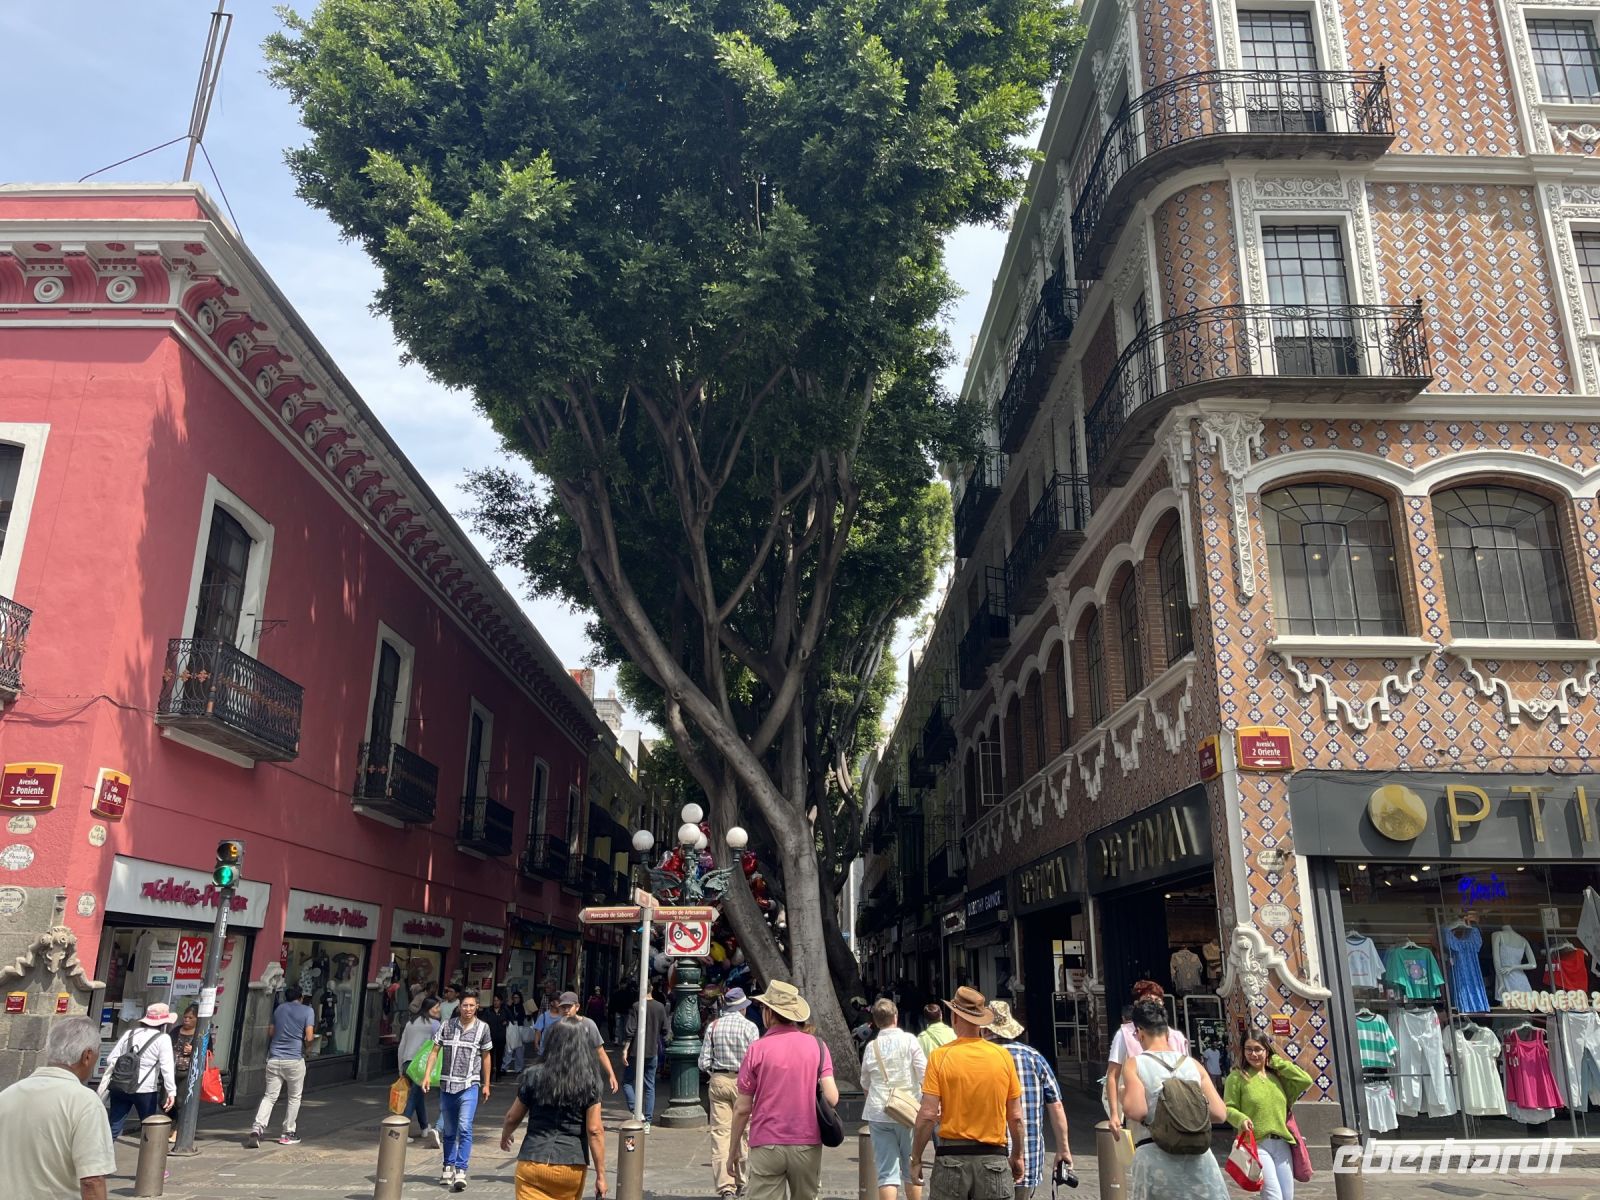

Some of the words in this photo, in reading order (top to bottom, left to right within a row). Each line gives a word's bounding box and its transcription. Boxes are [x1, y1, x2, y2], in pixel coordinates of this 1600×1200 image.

[1257, 748, 1281, 756] Oriente
[10, 787, 15, 795] 2
[16, 786, 45, 795] Poniente
[179, 940, 204, 963] 3x2
[177, 966, 188, 974] Ropa
[1502, 989, 1589, 1014] PRIMAVERA
